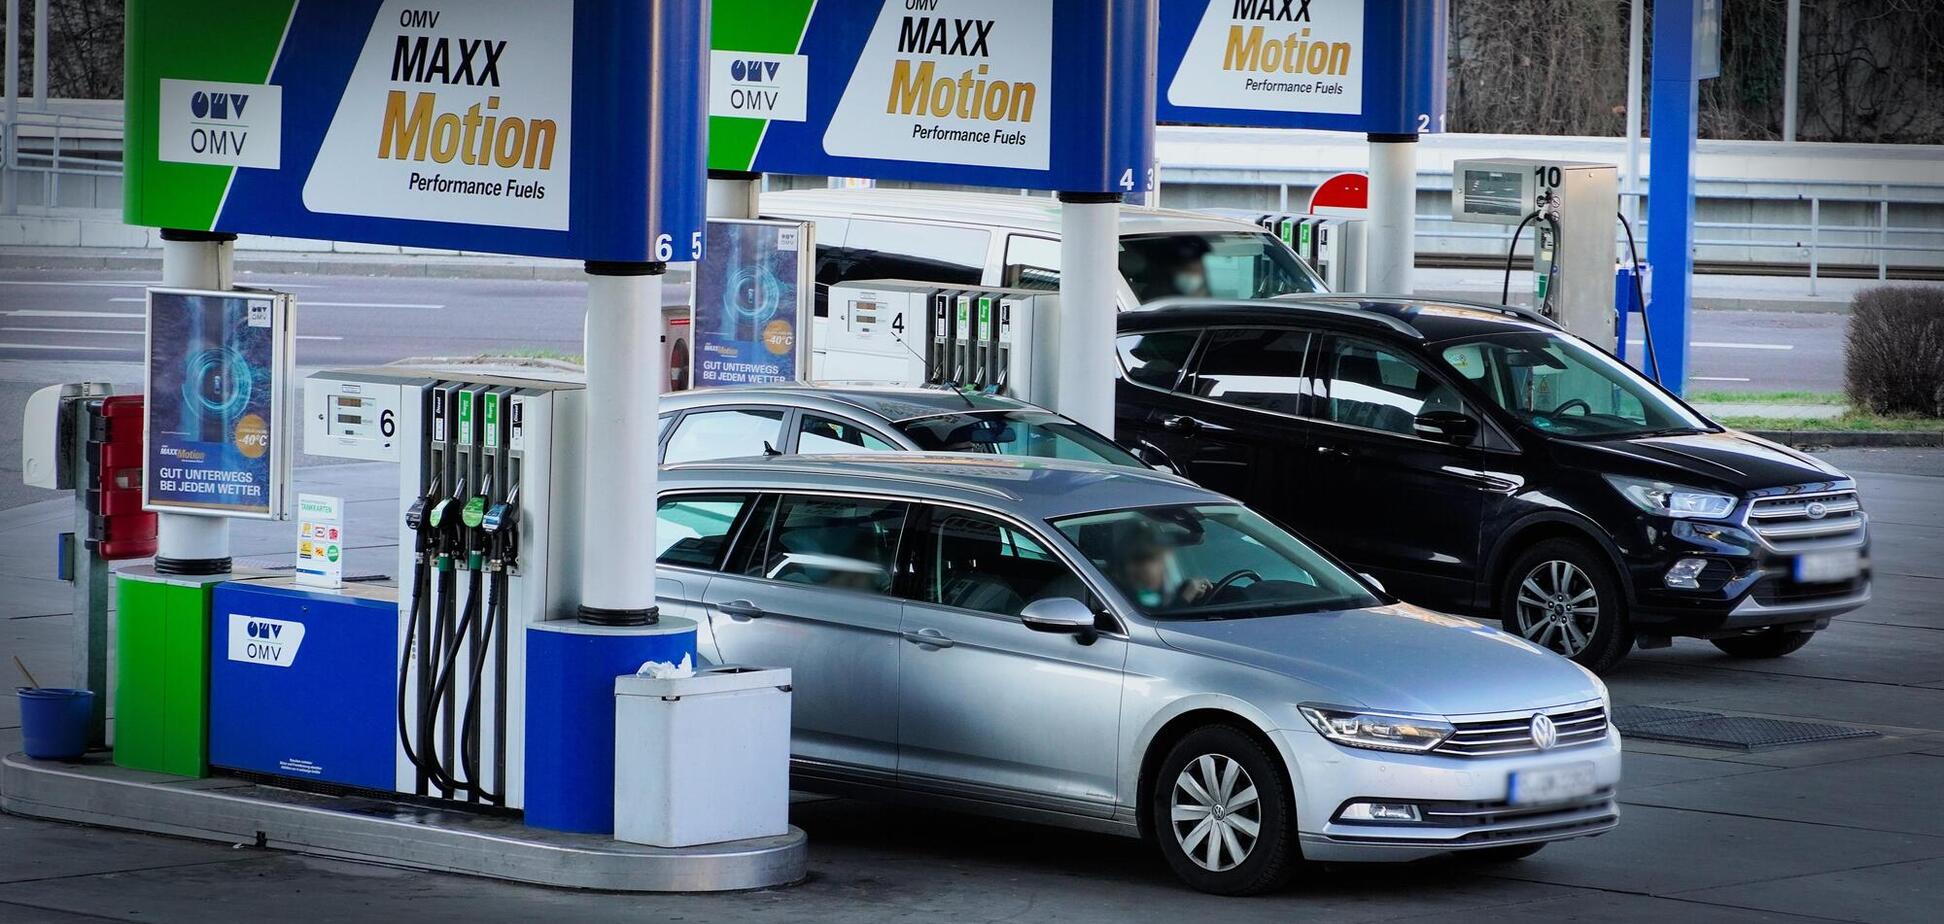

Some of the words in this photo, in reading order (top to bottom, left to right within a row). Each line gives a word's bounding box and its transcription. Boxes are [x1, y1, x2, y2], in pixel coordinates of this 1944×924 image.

[400, 9, 440, 28] OMV
[1232, 0, 1311, 22] MAXX
[898, 16, 995, 57] MAXX
[391, 35, 507, 87] MAXX
[1223, 25, 1351, 75] Motion
[886, 59, 1036, 122] Motion
[1245, 78, 1312, 93] Performance
[1315, 82, 1343, 95] Fuels
[731, 89, 778, 110] OMV
[378, 90, 557, 170] Motion
[1417, 114, 1430, 132] 2
[1439, 114, 1445, 132] 1
[191, 129, 247, 156] OMV
[912, 124, 990, 143] Performance
[993, 129, 1026, 146] Fuels
[409, 172, 502, 196] Performance
[506, 179, 545, 200] Fuels
[1120, 168, 1134, 190] 4
[1147, 168, 1153, 190] 3
[1535, 166, 1561, 188] 10
[655, 233, 672, 261] 6
[692, 231, 701, 260] 5
[892, 312, 904, 334] 4
[703, 361, 722, 370] GUT
[723, 362, 779, 374] UNTERWEGS
[703, 371, 716, 380] BEI
[718, 372, 746, 382] JEDEM
[380, 409, 395, 437] 6
[238, 434, 268, 446] -40°C
[160, 447, 178, 456] MAXX
[160, 467, 182, 479] GUT
[185, 469, 252, 483] UNTERWEGS
[160, 480, 176, 491] BEI
[178, 482, 215, 493] JEDEM
[217, 484, 261, 496] WETTER
[246, 643, 282, 661] OMV
